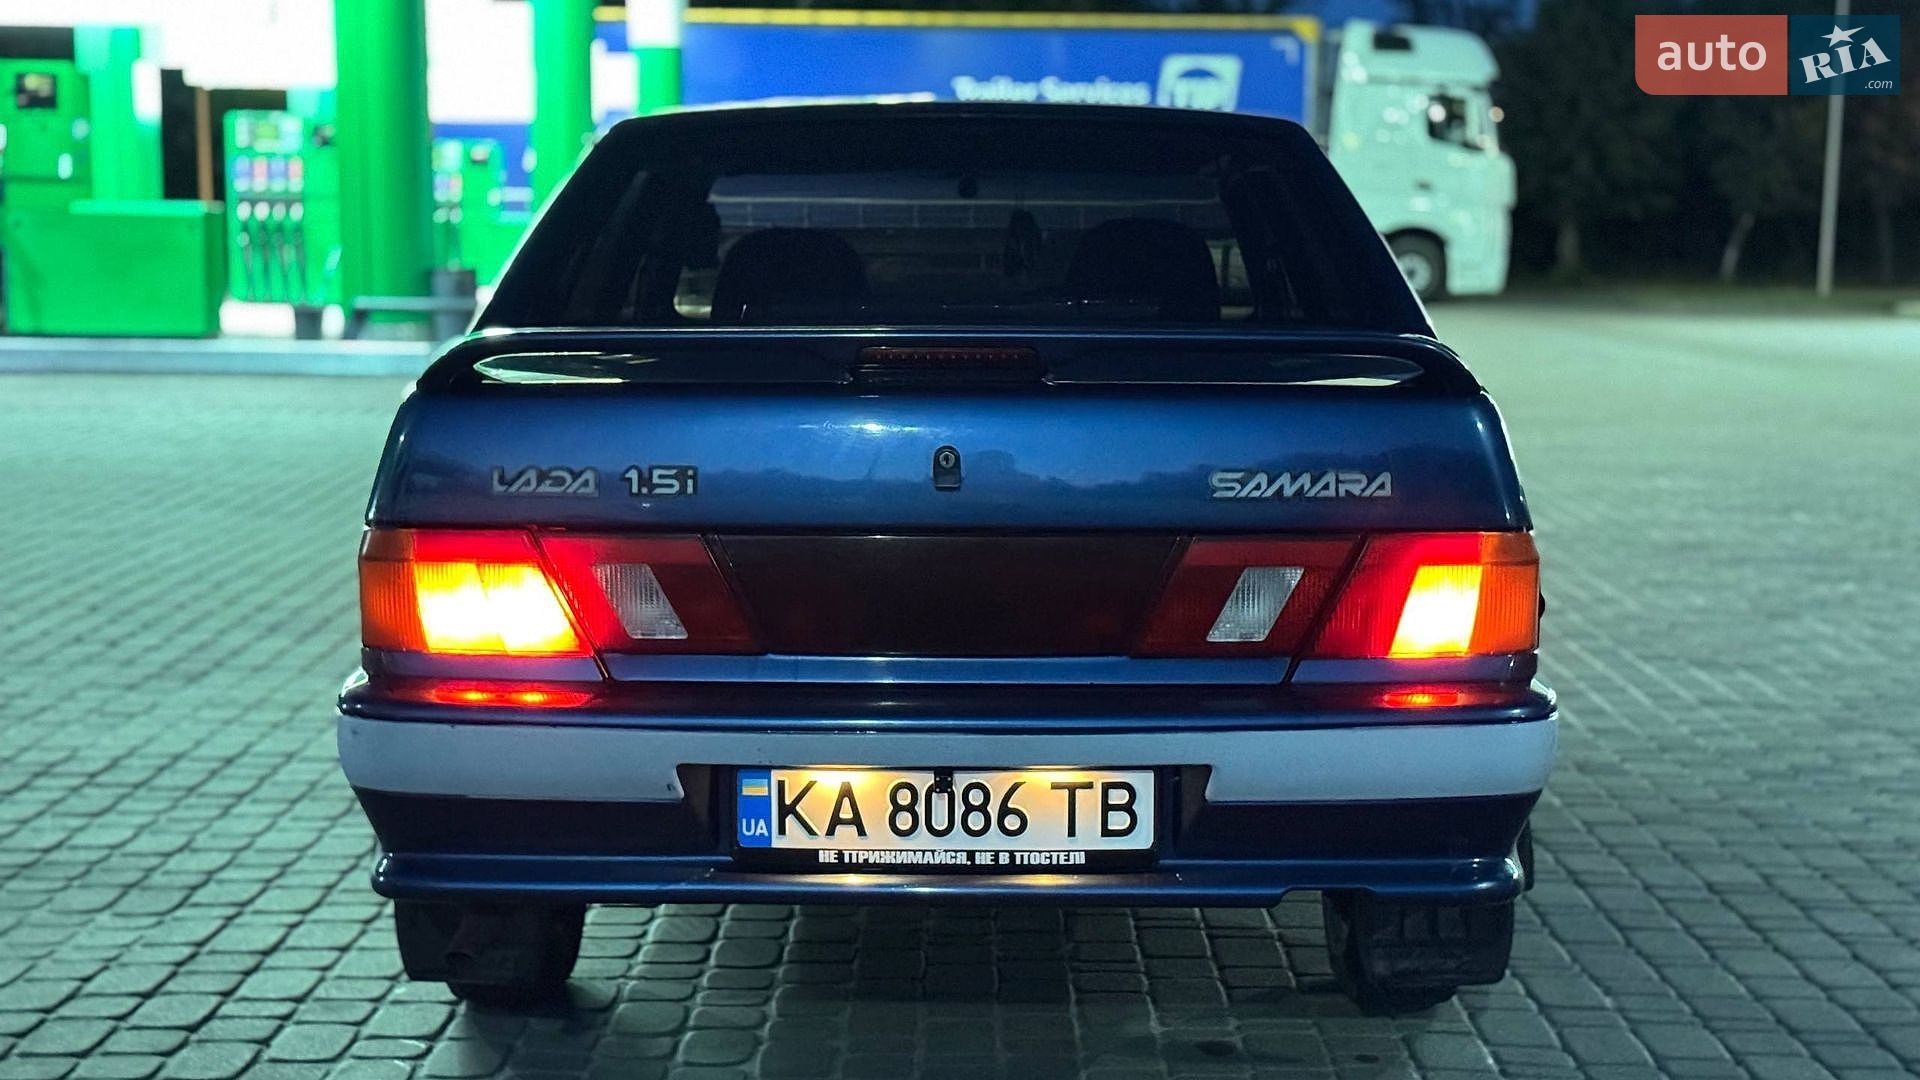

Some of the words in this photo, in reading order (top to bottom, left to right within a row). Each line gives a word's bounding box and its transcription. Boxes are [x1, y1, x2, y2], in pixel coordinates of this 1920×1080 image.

[492, 468, 597, 494] LADA
[624, 468, 695, 495] 1.5i
[1211, 471, 1393, 498] SAMARA
[776, 780, 868, 837] KA
[887, 781, 1029, 838] 8086
[1050, 781, 1138, 838] TB
[742, 819, 769, 836] UA
[818, 850, 838, 863] НЕ
[975, 851, 995, 865] НЕ
[999, 851, 1010, 865] В
